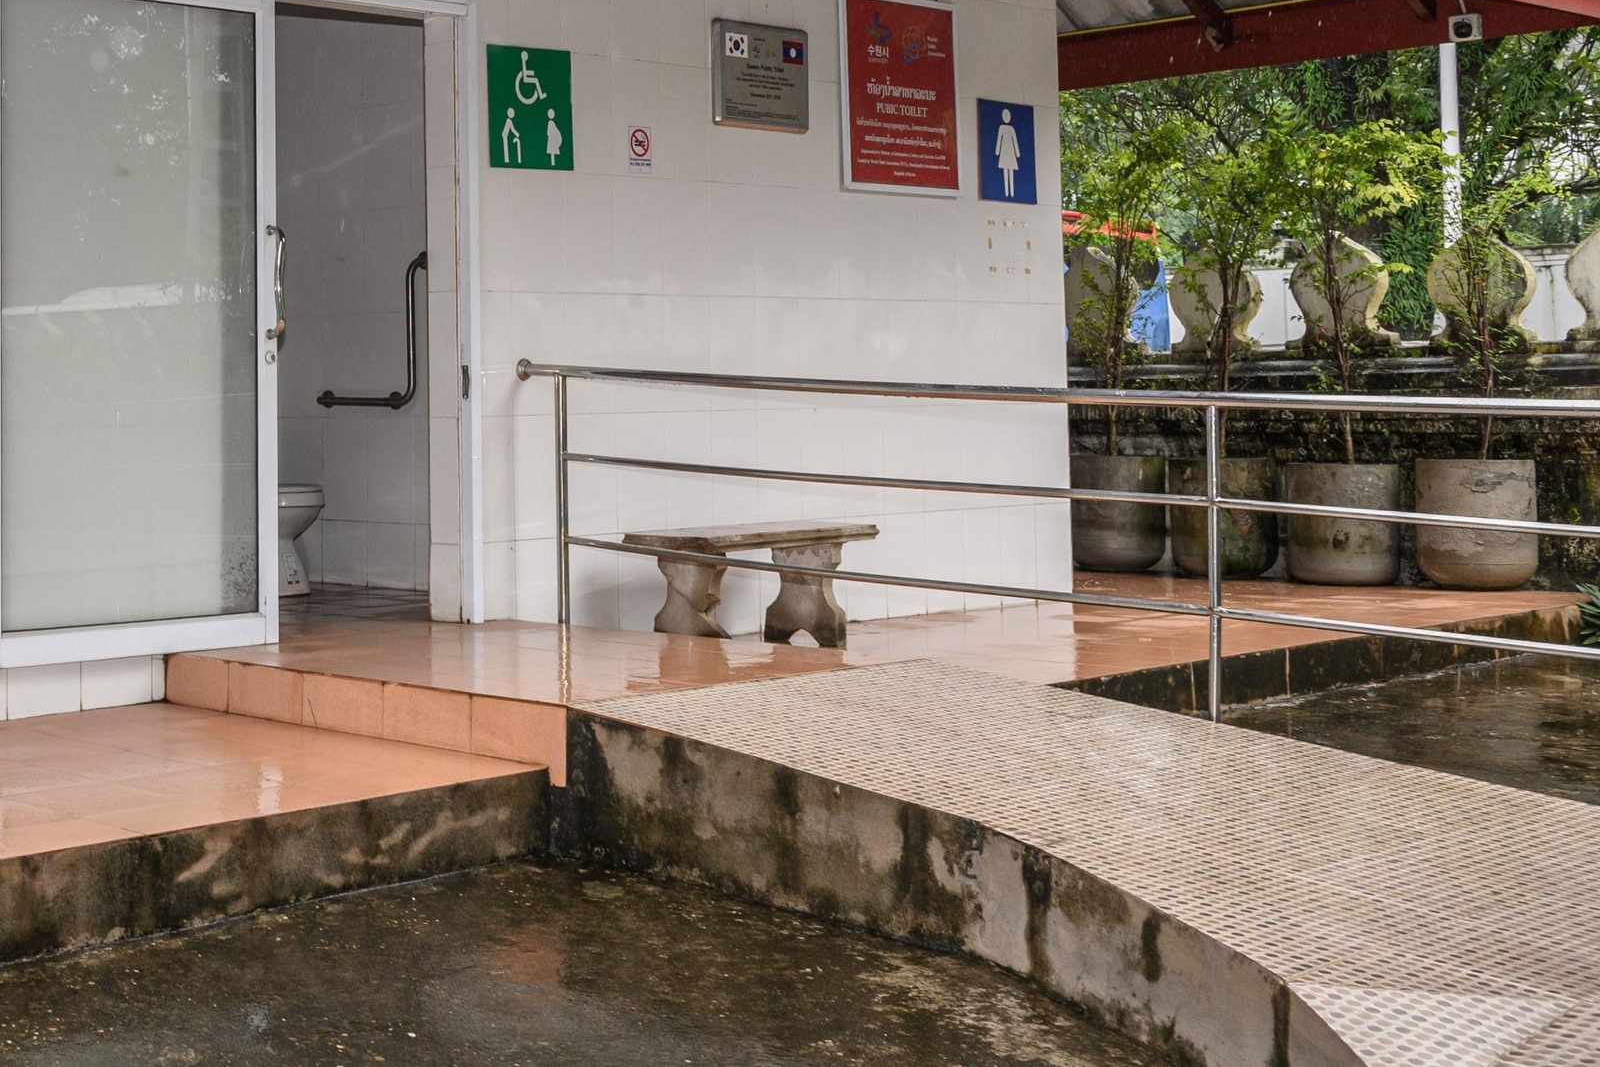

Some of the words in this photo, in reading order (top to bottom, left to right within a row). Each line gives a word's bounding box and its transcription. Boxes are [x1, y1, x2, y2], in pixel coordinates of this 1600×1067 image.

[867, 44, 890, 58] 수원시
[876, 102, 899, 115] PUBIC
[899, 105, 929, 118] TOILET
